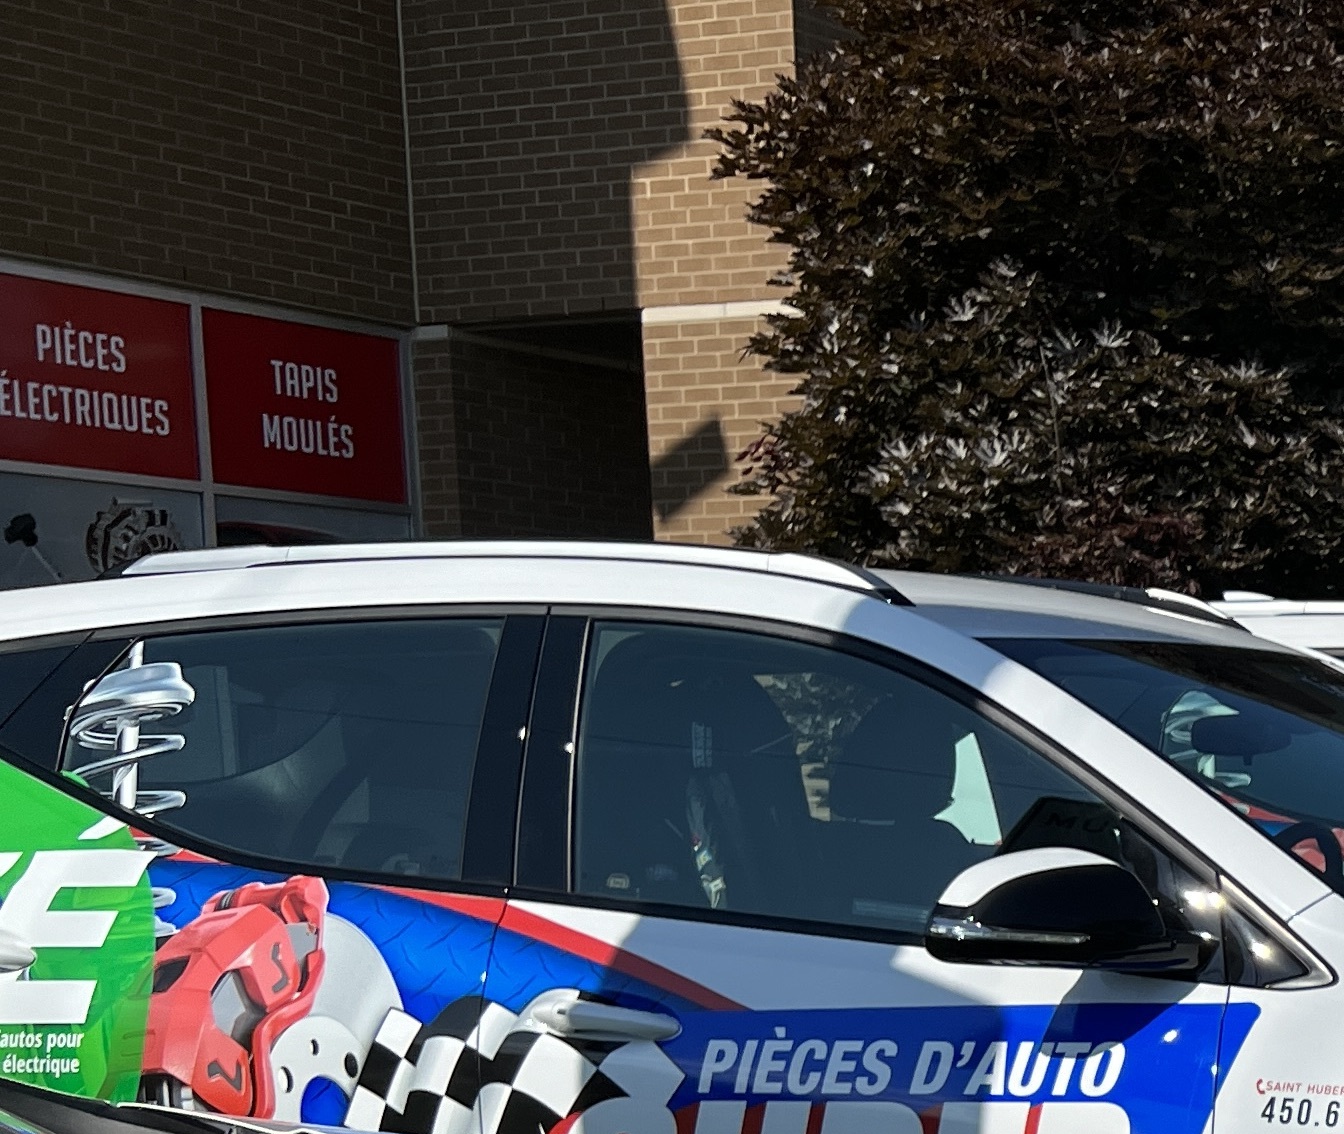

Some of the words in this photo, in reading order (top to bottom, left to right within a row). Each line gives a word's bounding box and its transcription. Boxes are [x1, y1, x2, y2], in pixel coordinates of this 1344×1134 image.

[35, 320, 127, 374] PIÈCES
[0, 369, 171, 436] ÉLECTRIQUES
[270, 358, 339, 403] TAPIS
[262, 414, 355, 459] MOULÉS
[0, 1028, 43, 1048] autos
[46, 1032, 85, 1053] pour
[697, 1026, 898, 1096] PIÈCES
[909, 1041, 1126, 1097] D'AUTO
[2, 1053, 81, 1078] électrique
[1265, 1080, 1302, 1093] SAINT
